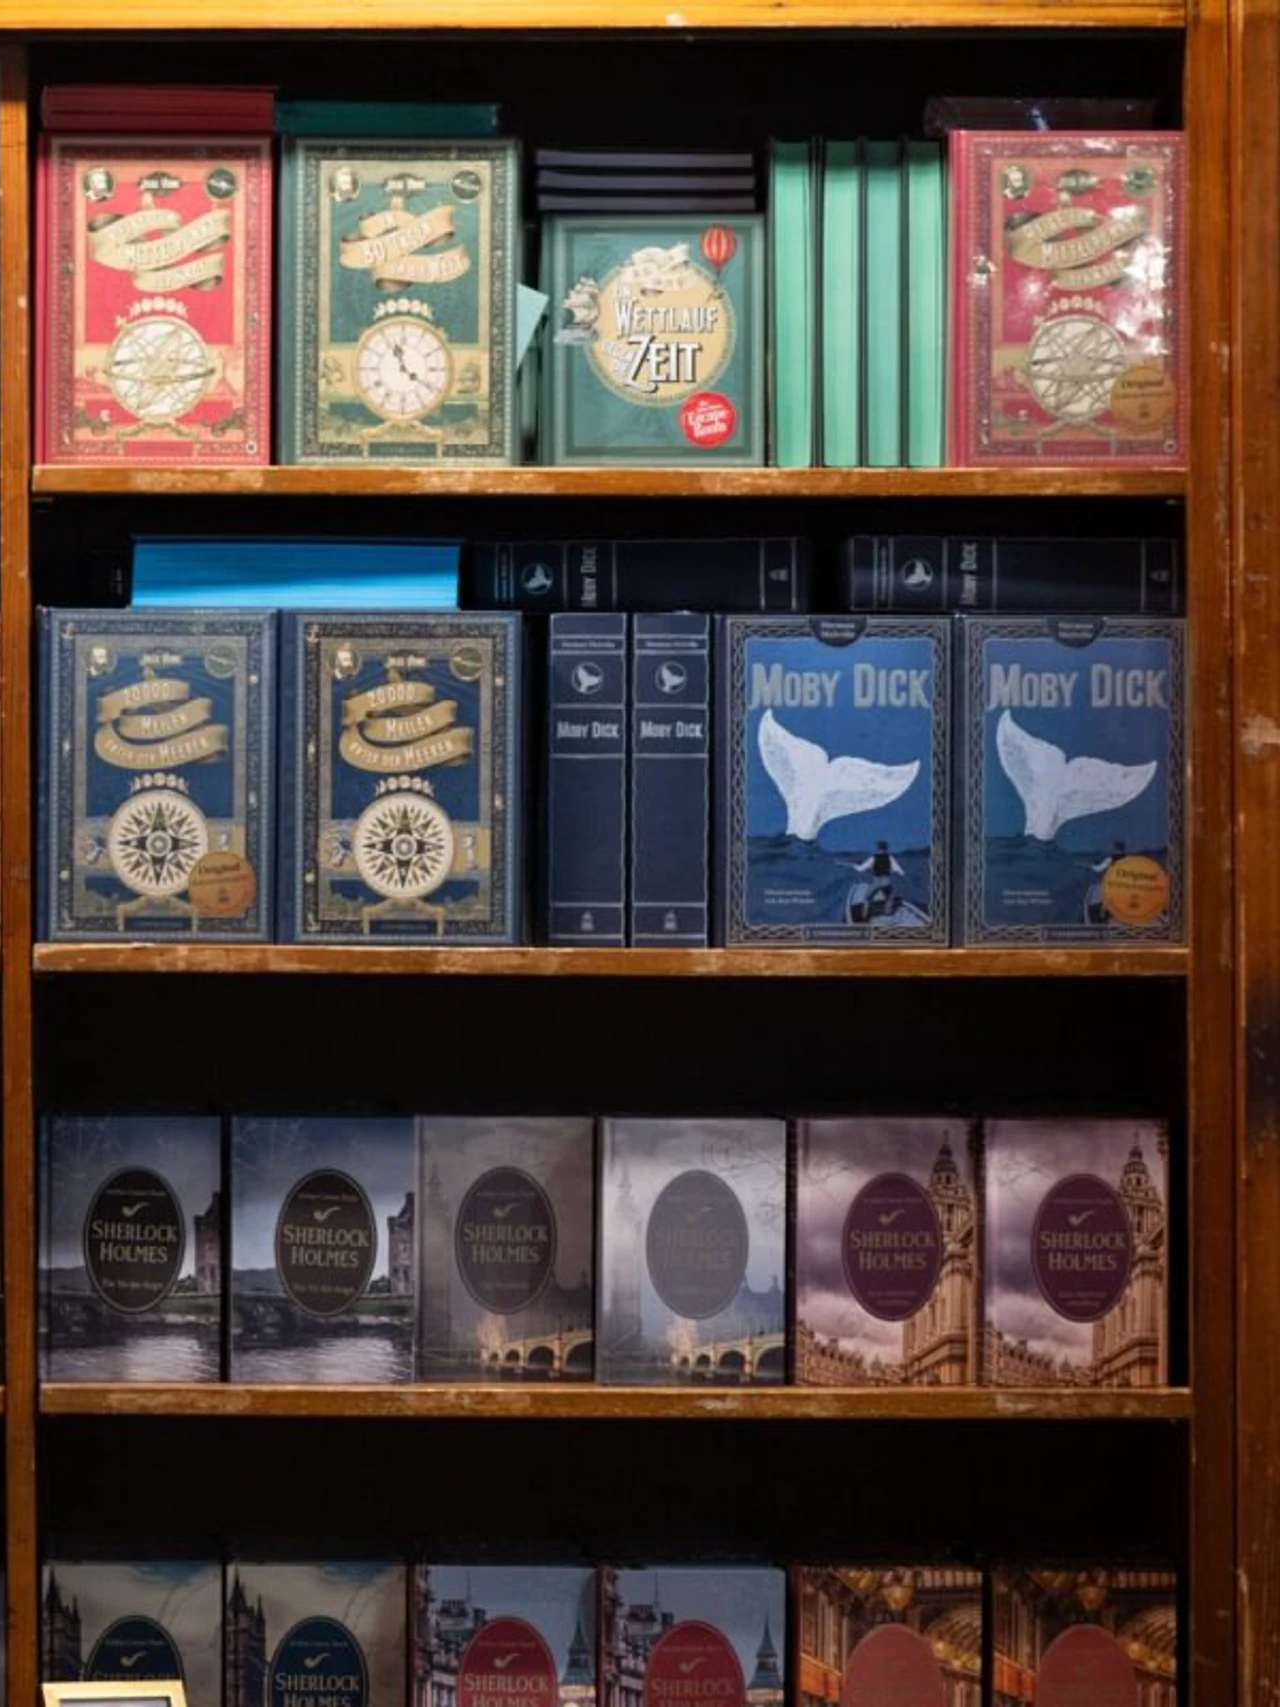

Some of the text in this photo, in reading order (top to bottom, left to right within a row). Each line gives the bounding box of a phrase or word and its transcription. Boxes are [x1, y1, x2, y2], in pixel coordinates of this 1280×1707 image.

[615, 298, 718, 339] WETTLAUF
[625, 333, 703, 393] ZEIT
[748, 663, 931, 710] MOBY DICK
[985, 663, 1168, 711] MOBY DICK
[386, 714, 434, 738] MEILEN
[556, 721, 620, 739] MOBY DICK
[640, 721, 703, 739] MOBY DICK
[91, 1220, 177, 1241] SHERLOCK
[283, 1224, 369, 1247] SHERLOCK
[463, 1222, 548, 1242] SHERLOCK
[850, 1229, 936, 1249] SHERLOCK
[1040, 1230, 1127, 1250] SHERLOCK
[100, 1242, 168, 1264] HOLMES
[292, 1246, 359, 1268] HOLMES
[472, 1243, 540, 1264] HOLMES
[859, 1251, 926, 1271] HOLMES
[1048, 1251, 1117, 1271] HOLMES
[275, 1672, 360, 1691] SHERLOCK
[463, 1672, 549, 1693] SHERLOCK
